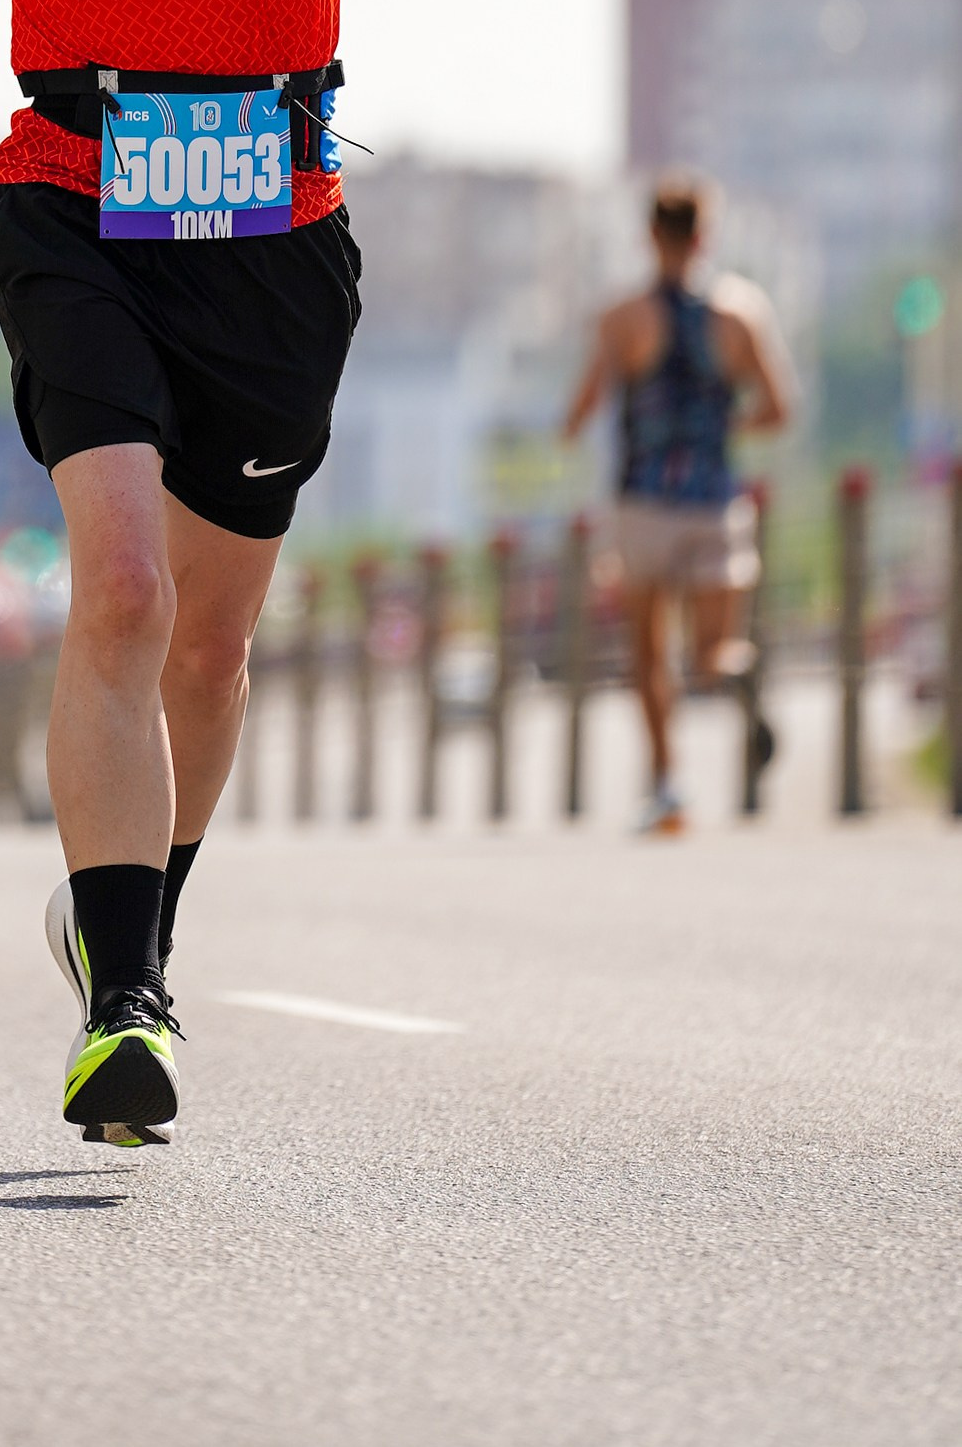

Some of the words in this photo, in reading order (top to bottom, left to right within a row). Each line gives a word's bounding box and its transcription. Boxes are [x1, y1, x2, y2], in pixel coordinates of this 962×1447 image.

[124, 110, 150, 122] ПСБ
[189, 100, 221, 132] 10
[113, 132, 282, 206] 50053
